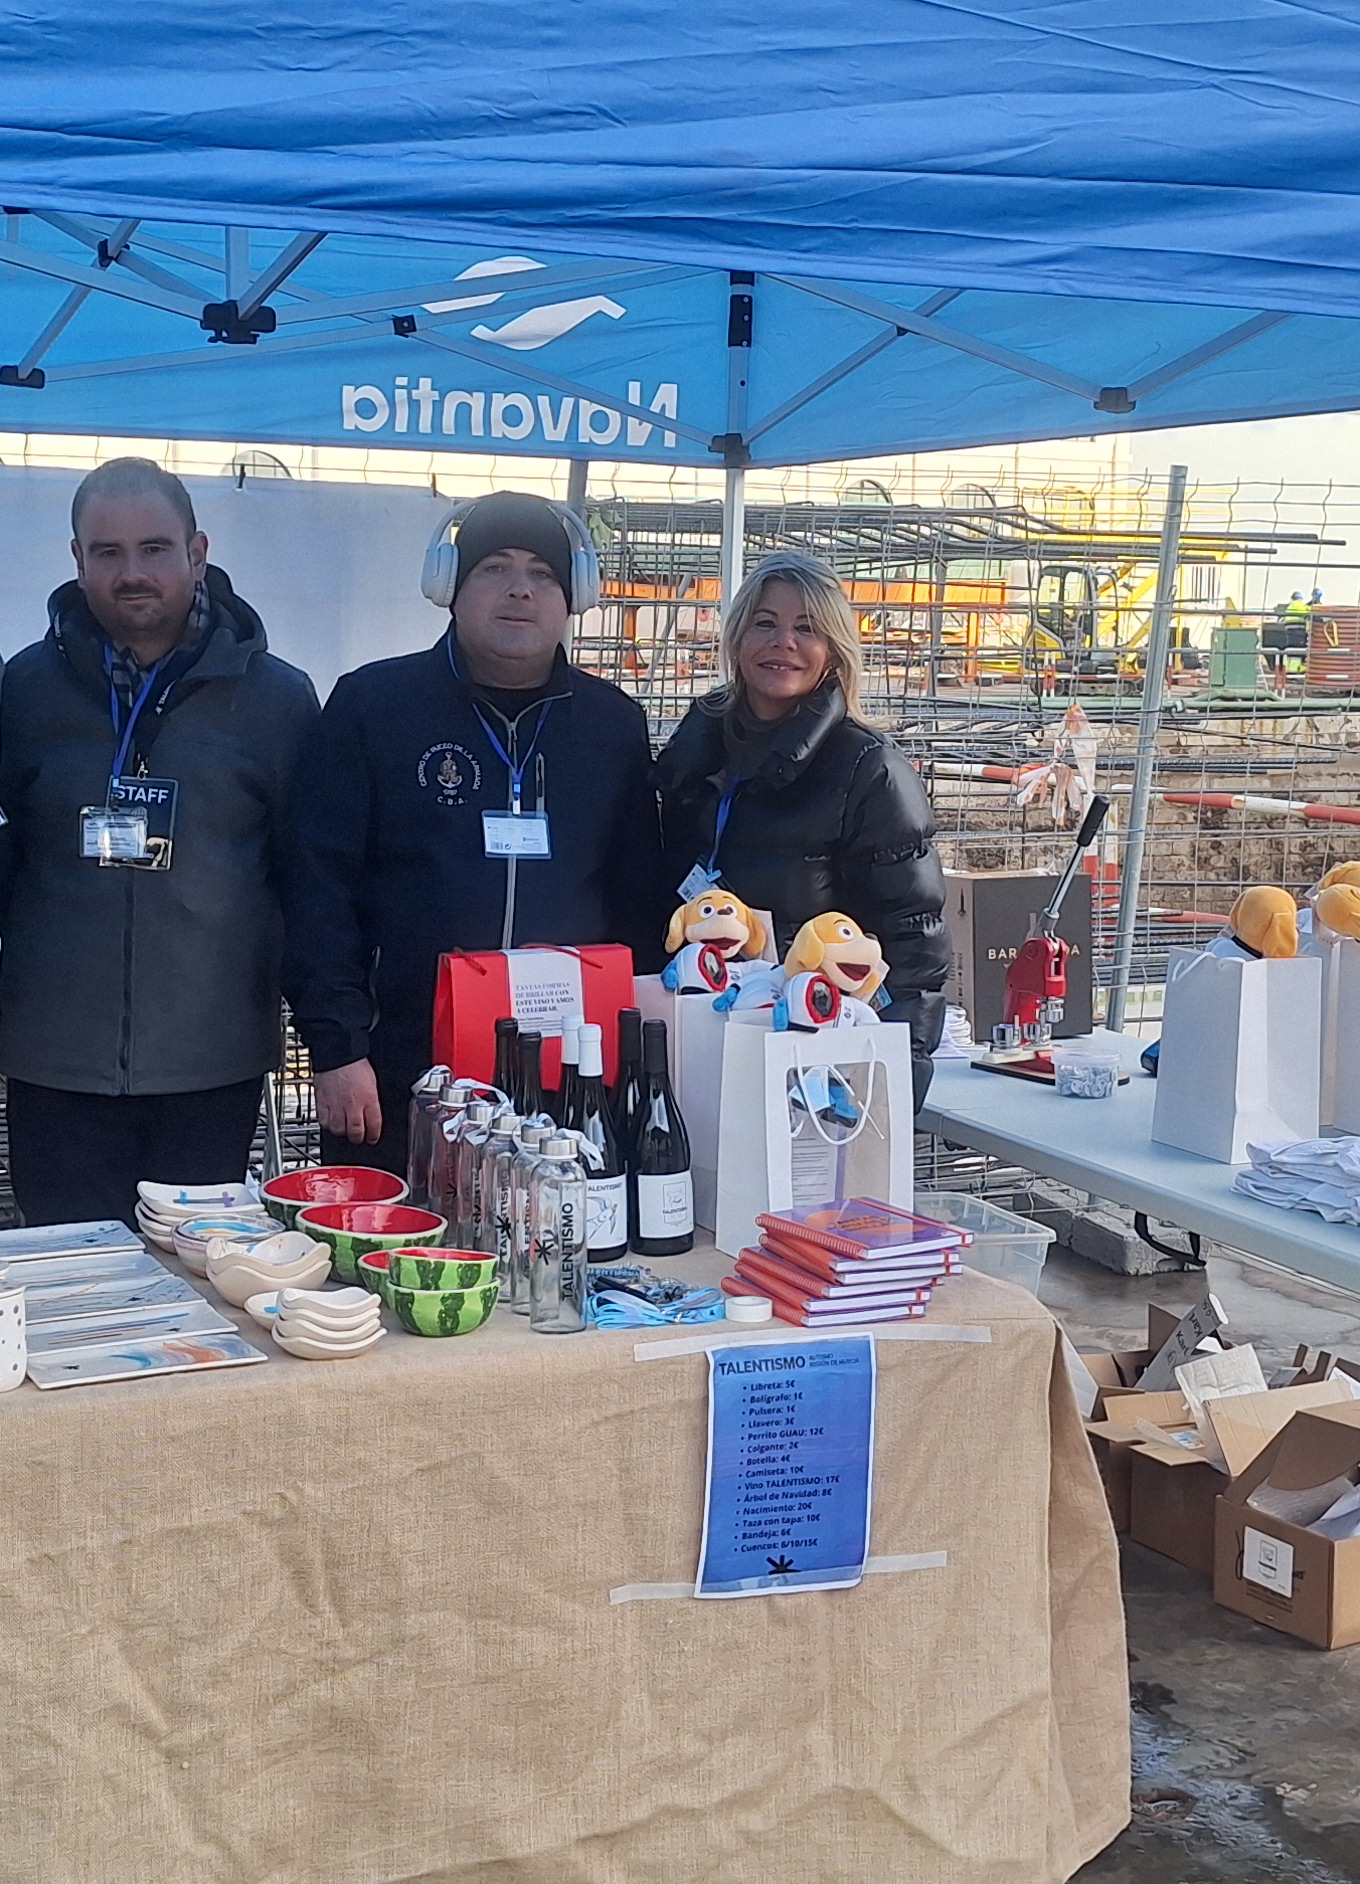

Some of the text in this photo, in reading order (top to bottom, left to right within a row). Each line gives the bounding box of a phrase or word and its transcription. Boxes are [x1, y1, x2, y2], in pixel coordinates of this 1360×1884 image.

[116, 785, 169, 804] STAFF
[586, 1182, 622, 1192] ALENTISMO
[561, 1202, 574, 1302] TALENTISMO
[718, 1356, 806, 1376] TALENTISMO
[750, 1379, 796, 1392] Libreta: 5€
[750, 1392, 803, 1404] Bolígrafo: 1€
[749, 1405, 796, 1417] Pulsera: 1€
[748, 1420, 782, 1428] Llavero:
[748, 1427, 824, 1441] Perrito GUAU: 12€
[747, 1443, 787, 1455] Colgante:
[746, 1456, 779, 1466] Botella:
[745, 1465, 804, 1478] Camiseta: 10€
[744, 1475, 840, 1490] Vino TALENTISMO: 17€
[769, 1492, 780, 1501] de
[781, 1489, 820, 1500] Navidad:
[742, 1502, 813, 1516] Nacimiento: 20€
[742, 1518, 762, 1528] Taza
[764, 1518, 780, 1526] con
[781, 1516, 804, 1526] tapa:
[742, 1530, 779, 1541] Bandeja:
[741, 1542, 779, 1553] Cuencos:
